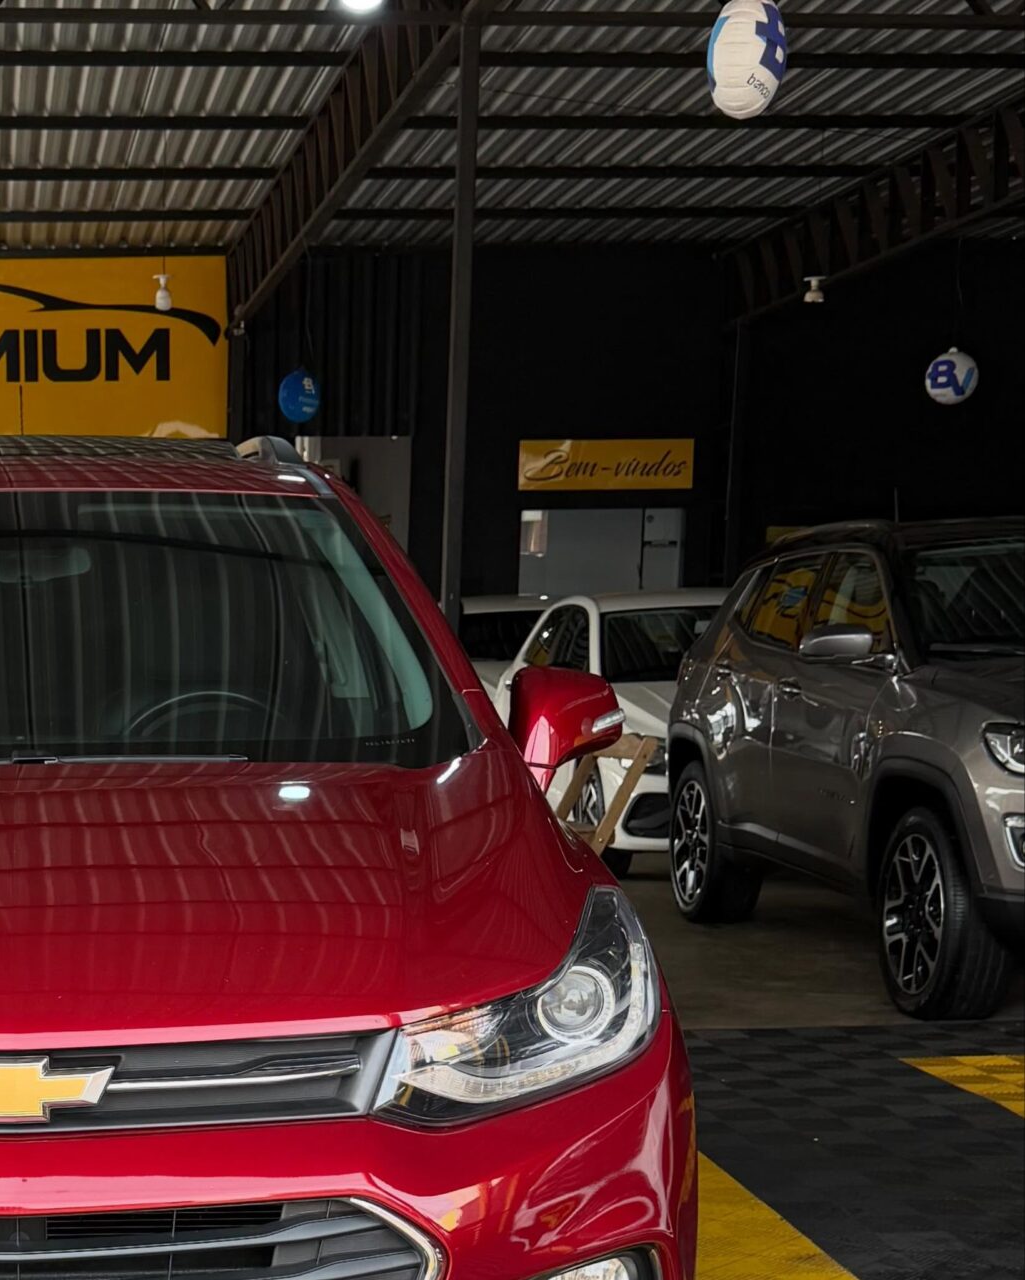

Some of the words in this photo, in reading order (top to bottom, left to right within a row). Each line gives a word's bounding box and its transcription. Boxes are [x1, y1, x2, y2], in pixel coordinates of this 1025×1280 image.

[747, 73, 771, 99] banco
[927, 360, 975, 397] BV
[524, 449, 687, 481] Bem-vindos
